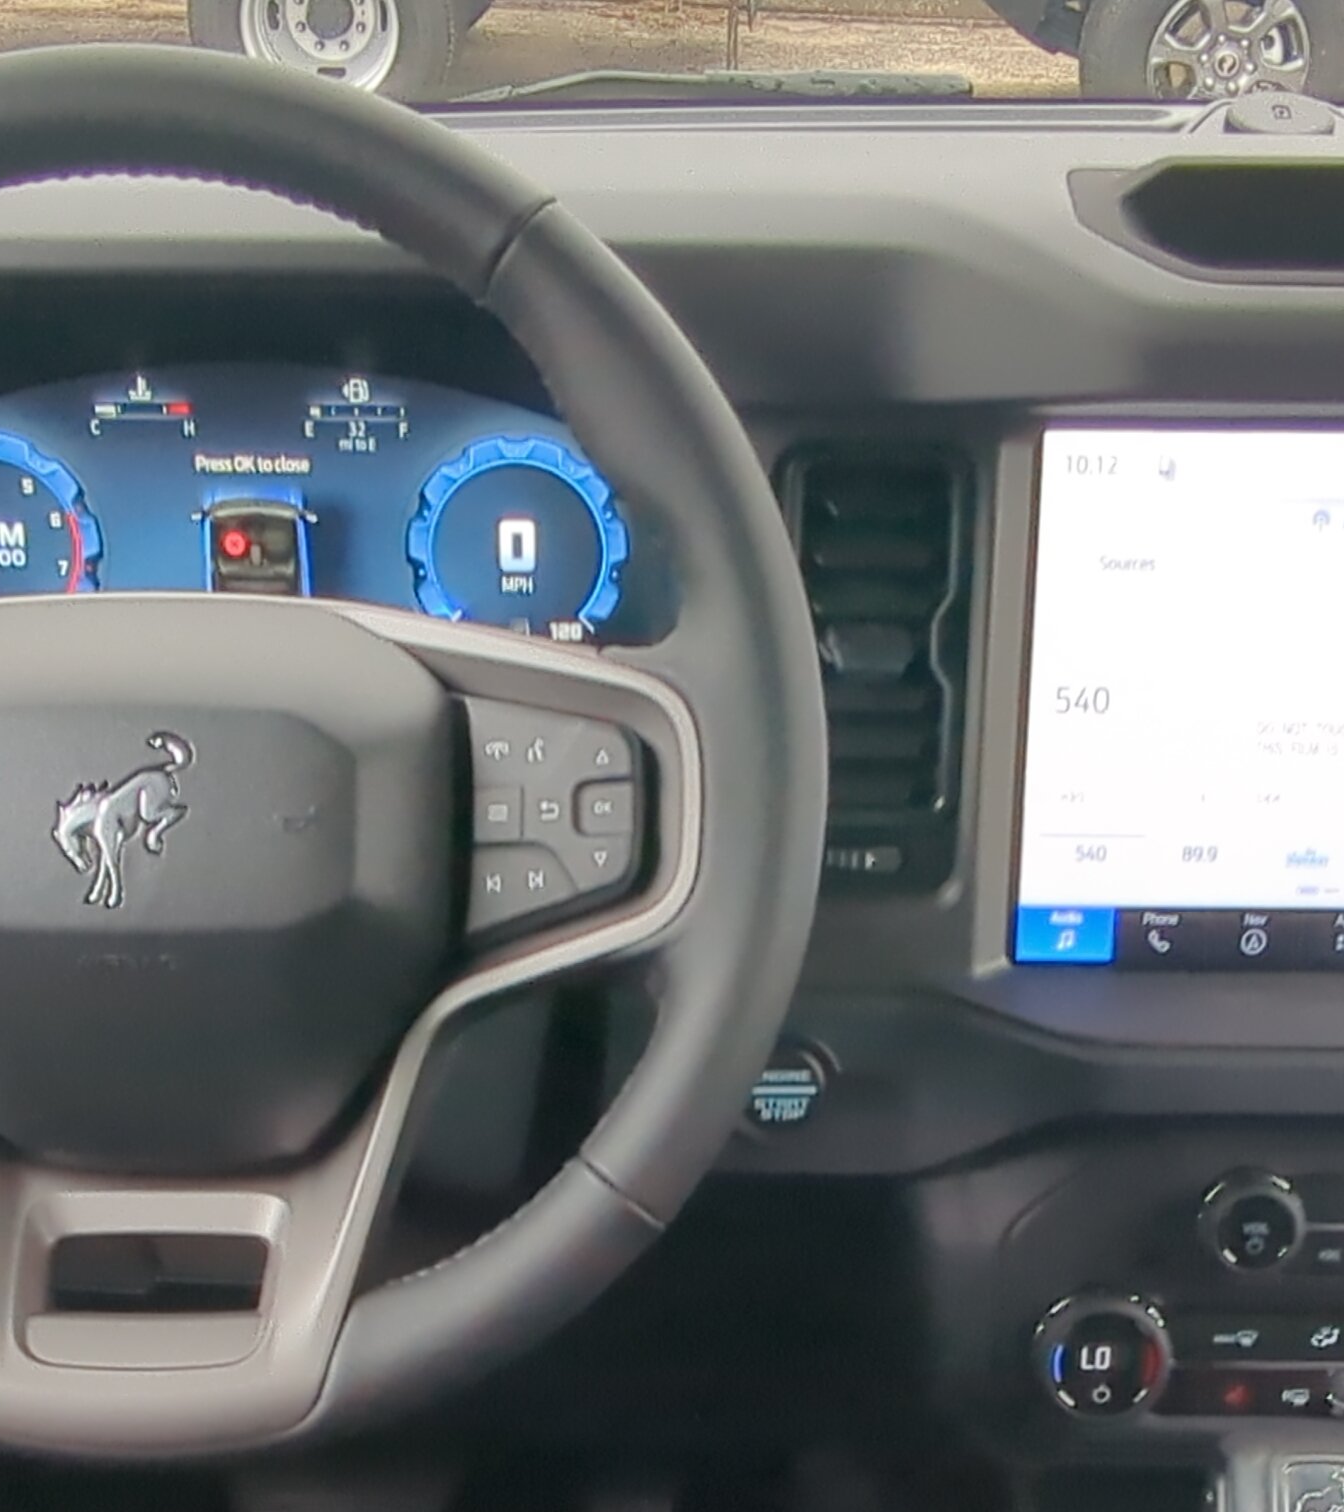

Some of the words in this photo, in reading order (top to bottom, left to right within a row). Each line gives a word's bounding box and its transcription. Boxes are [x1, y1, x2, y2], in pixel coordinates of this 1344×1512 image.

[90, 420, 101, 436] C
[183, 421, 196, 437] H
[305, 421, 315, 437] E
[347, 421, 367, 437] 32
[398, 421, 409, 438] F
[195, 455, 232, 473] Press
[234, 456, 255, 472] OK
[256, 457, 273, 472] to
[275, 455, 311, 473] close
[21, 477, 34, 494] 5
[49, 512, 62, 528] 6
[499, 519, 536, 573] 0
[58, 560, 69, 577] 7
[1100, 554, 1156, 572] Sources
[501, 576, 534, 594] MPH
[1055, 685, 1111, 714] 540
[593, 800, 613, 815] OK
[1075, 845, 1108, 862] 540
[1181, 845, 1218, 862] 89.9
[1142, 911, 1179, 927] Phone
[1243, 913, 1268, 927] Nav
[1080, 1345, 1111, 1372] LO
